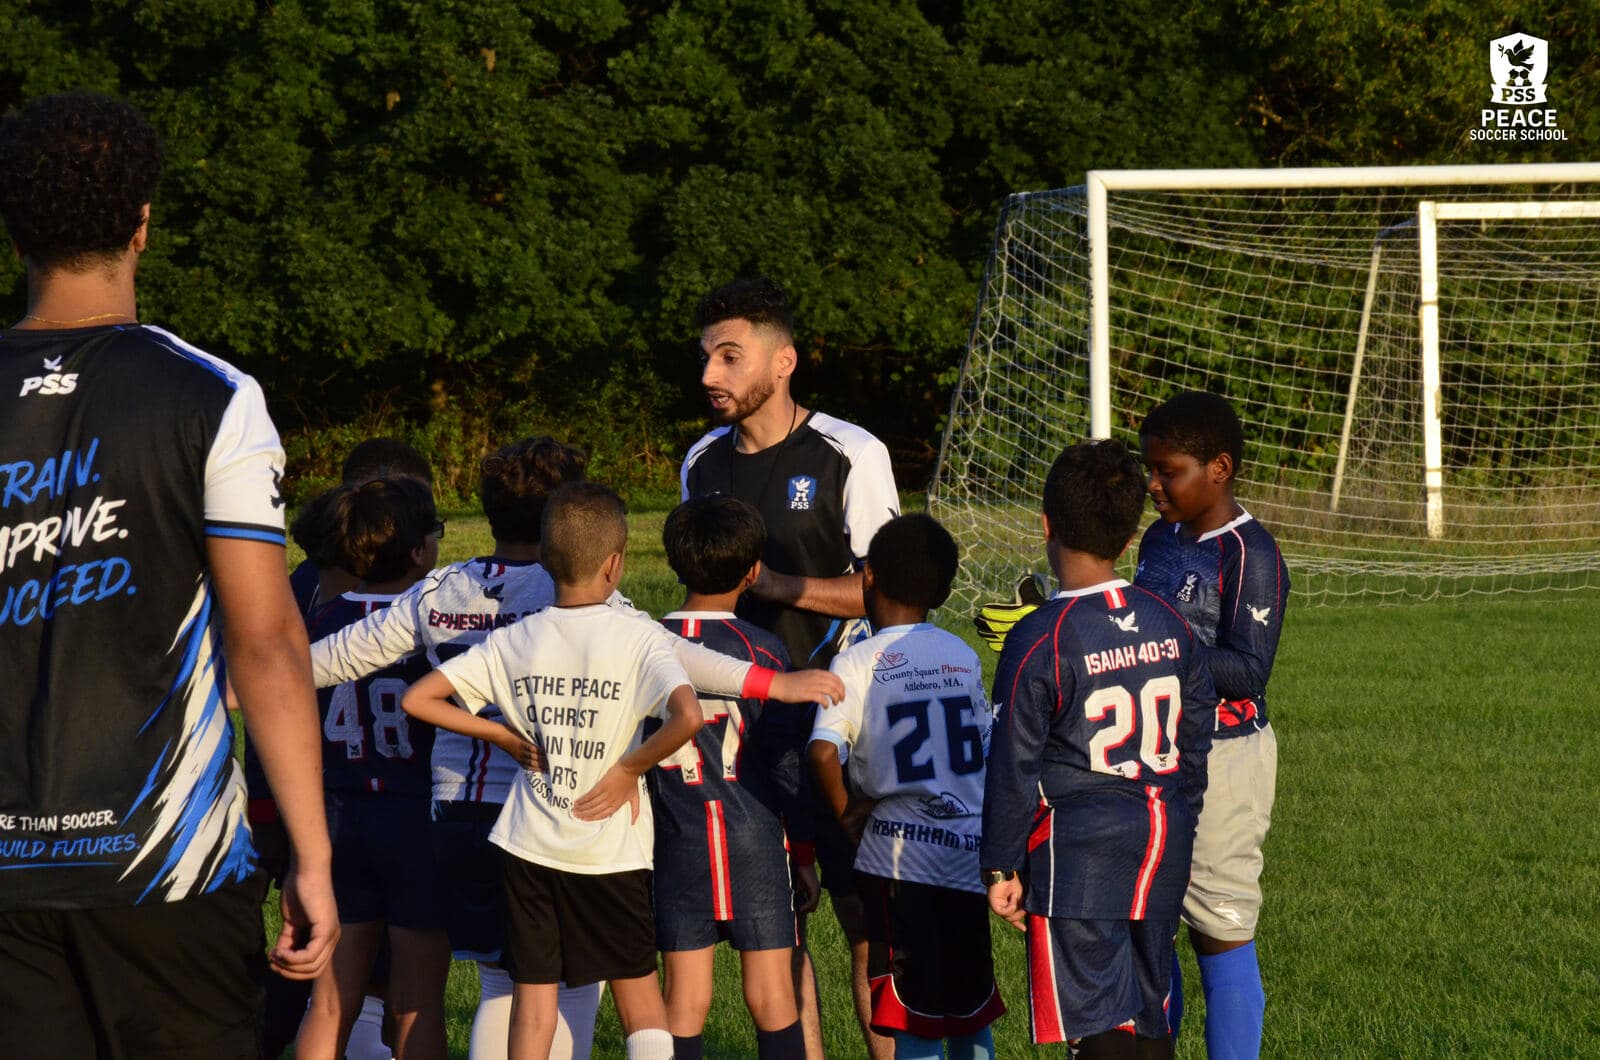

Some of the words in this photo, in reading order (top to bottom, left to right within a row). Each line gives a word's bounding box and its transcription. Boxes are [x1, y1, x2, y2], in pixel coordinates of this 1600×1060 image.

[19, 373, 79, 397] PSS
[790, 501, 809, 510] PSS
[1084, 647, 1138, 675] ISAIAH
[1138, 638, 1181, 665] 40:31
[882, 670, 914, 682] County
[914, 667, 940, 679] Square
[514, 676, 530, 697] ET
[532, 675, 566, 696] THE
[571, 677, 622, 701] PEACE
[324, 677, 415, 761] 48
[526, 704, 537, 723] O
[887, 695, 985, 784] 26
[1084, 675, 1182, 780] 20
[545, 736, 564, 756] IN
[569, 738, 606, 760] YOUR
[552, 766, 578, 790] RTS
[0, 814, 16, 830] RE
[19, 815, 58, 832] THAN
[61, 809, 118, 831] SOCCER.
[0, 839, 46, 859] UILD
[52, 833, 142, 859] FUTURES.
[872, 818, 960, 849] ABRAHAM
